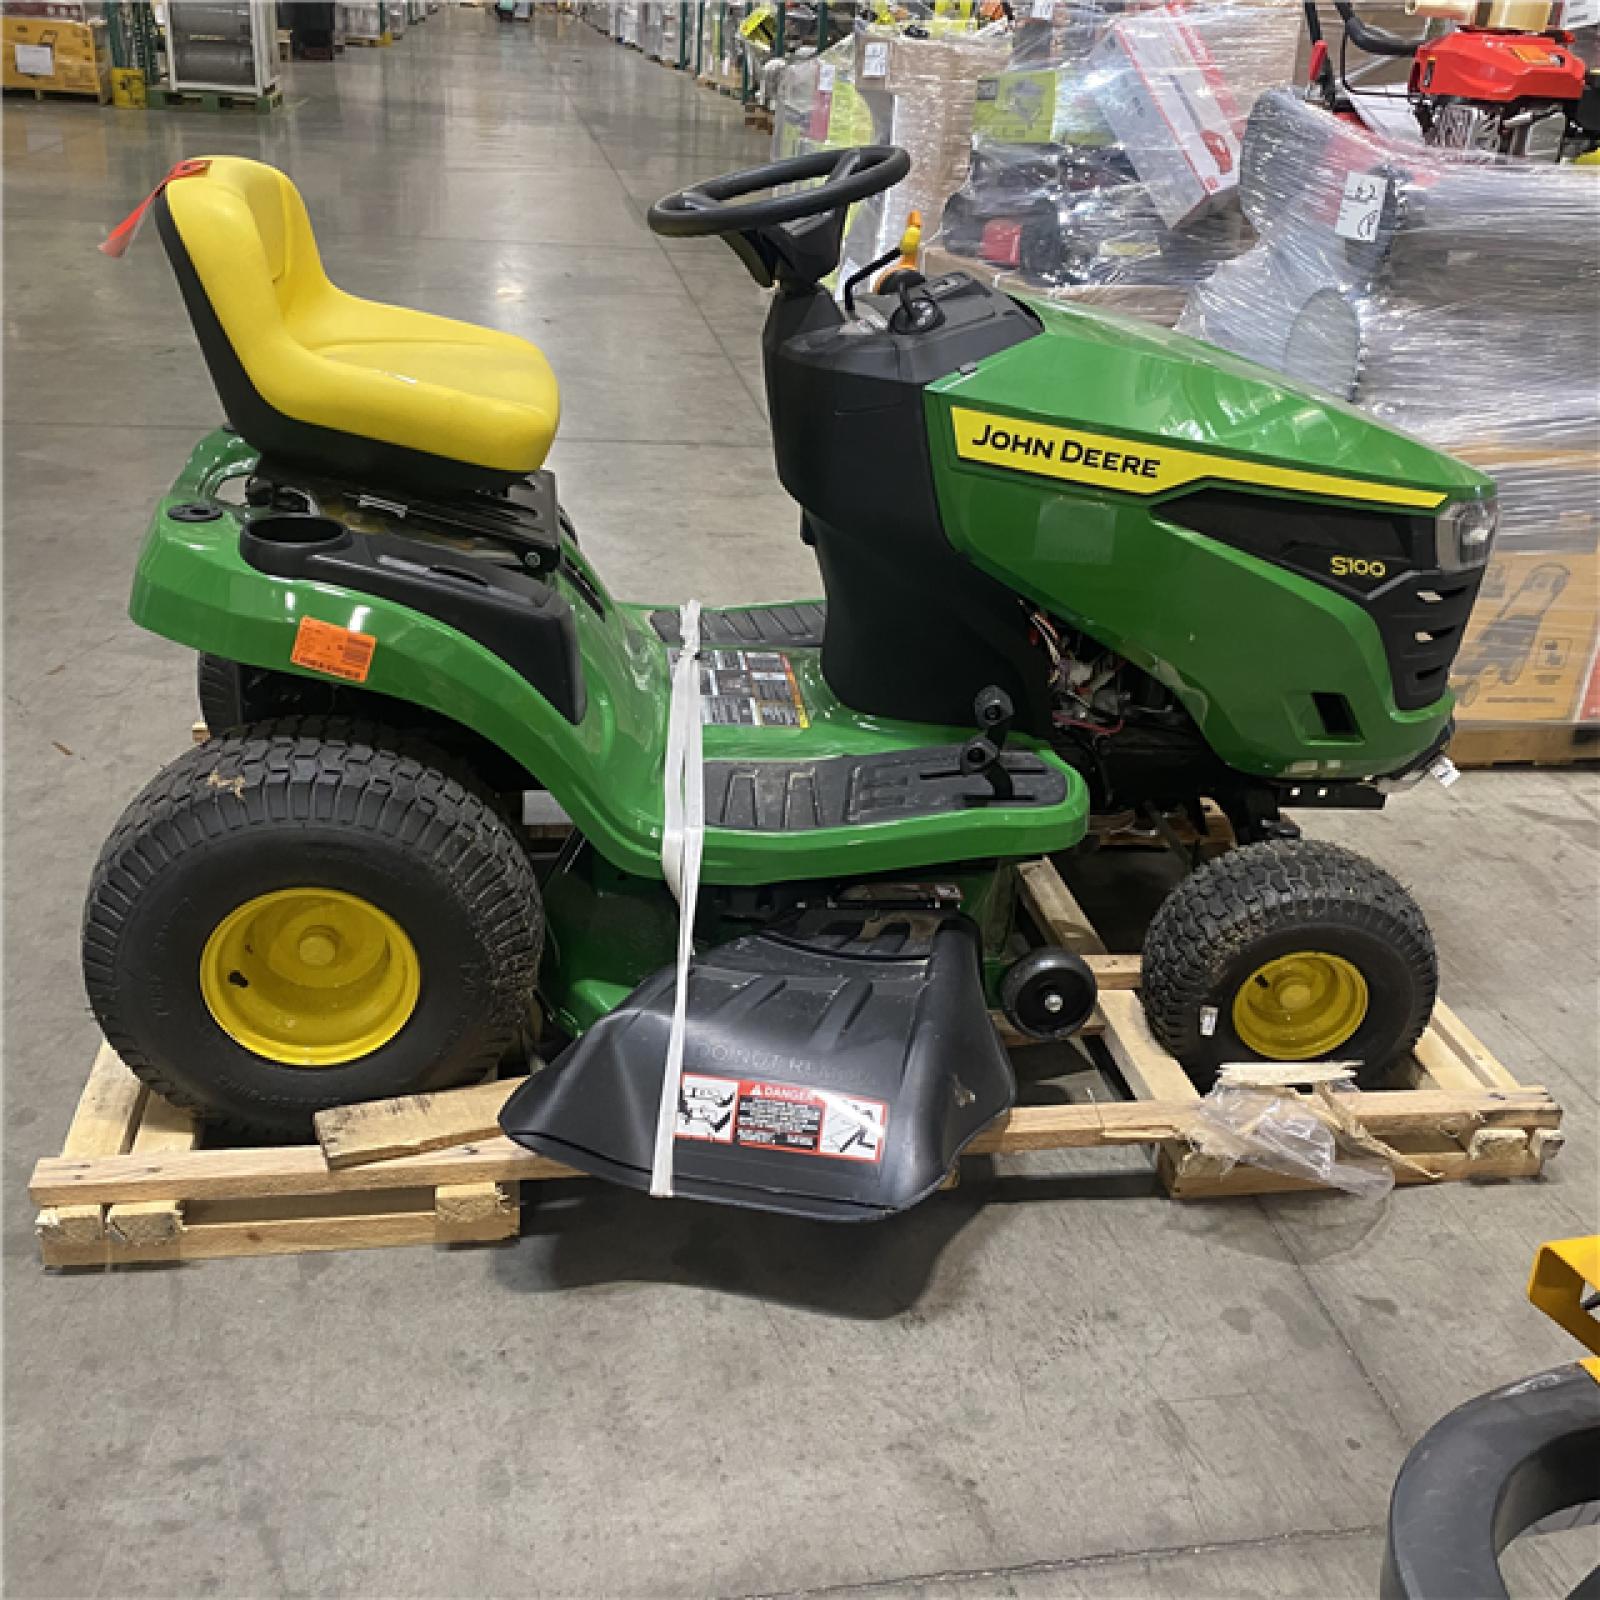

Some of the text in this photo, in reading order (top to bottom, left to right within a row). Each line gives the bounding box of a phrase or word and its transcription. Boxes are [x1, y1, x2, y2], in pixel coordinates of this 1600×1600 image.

[972, 424, 1161, 478] JOHN DEERE
[1330, 555, 1386, 577] S100
